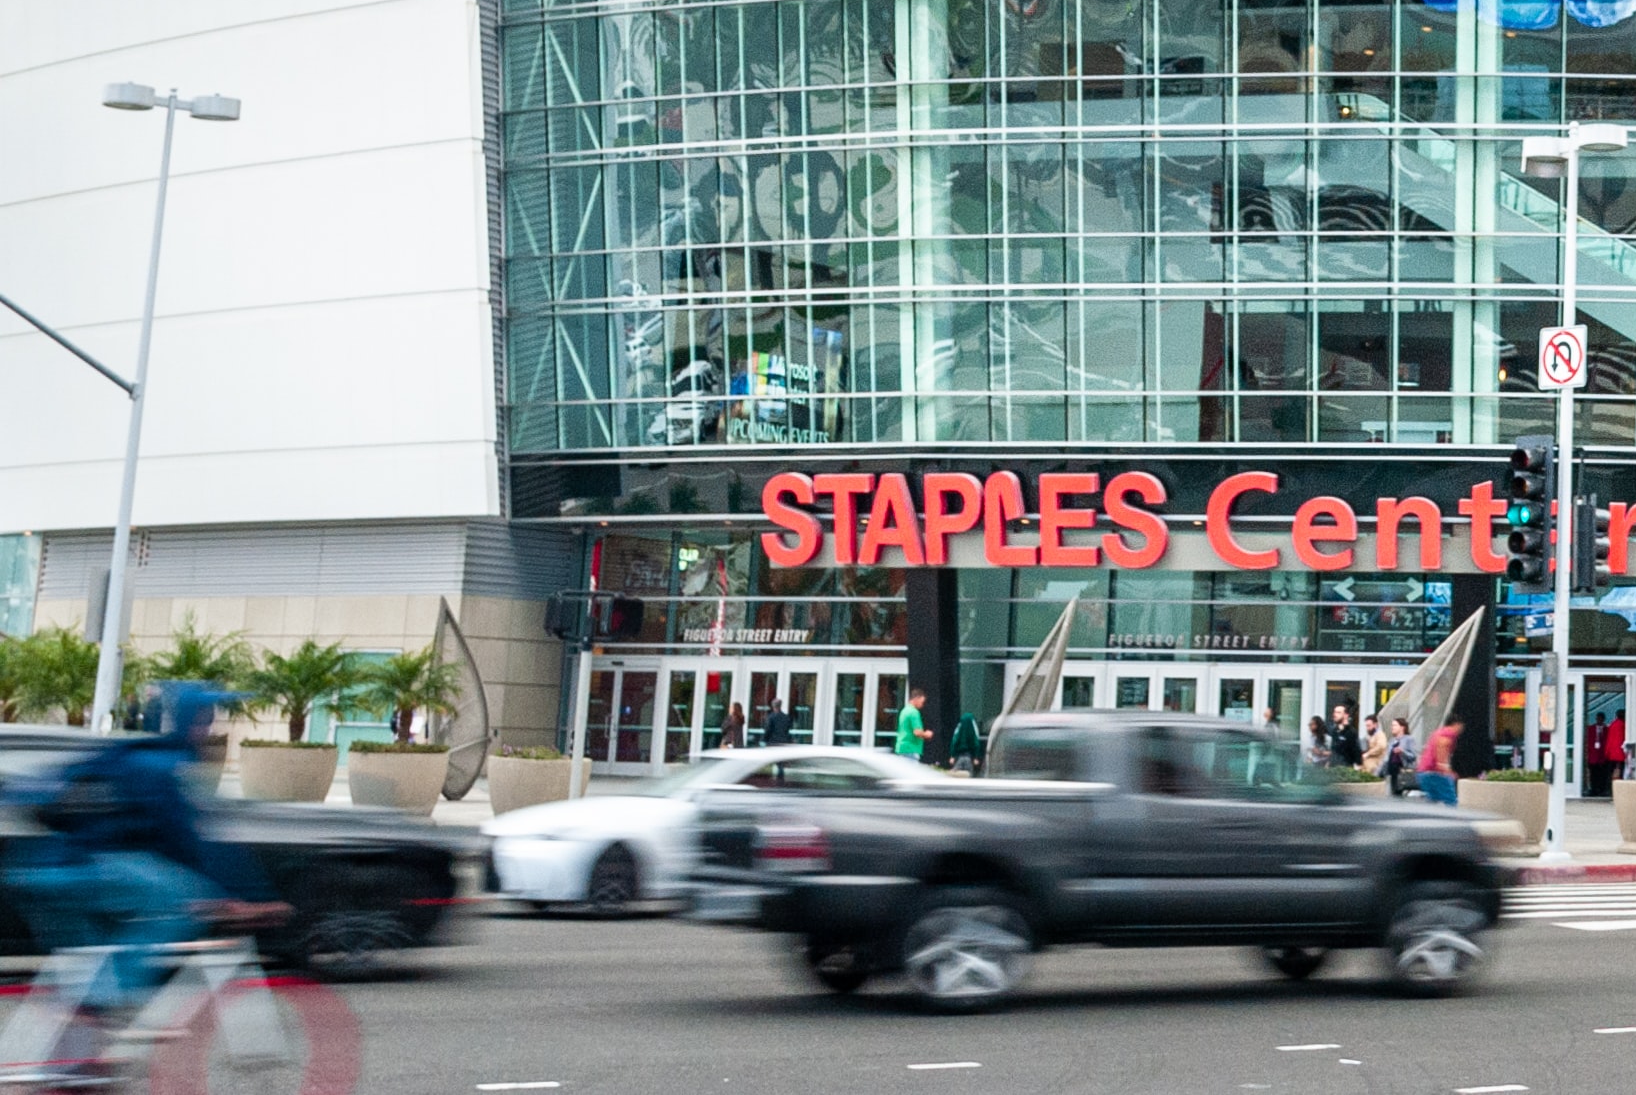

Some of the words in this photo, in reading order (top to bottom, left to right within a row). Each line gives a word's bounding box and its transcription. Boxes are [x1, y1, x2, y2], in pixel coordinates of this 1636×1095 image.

[791, 426, 830, 444] EVETS
[760, 471, 1170, 570] STAPLES
[735, 628, 773, 643] STREET
[773, 629, 809, 643] ENTRY
[1108, 634, 1185, 648] FIGUEROA
[1193, 634, 1251, 648] STREET
[1259, 635, 1310, 649] ENTRY
